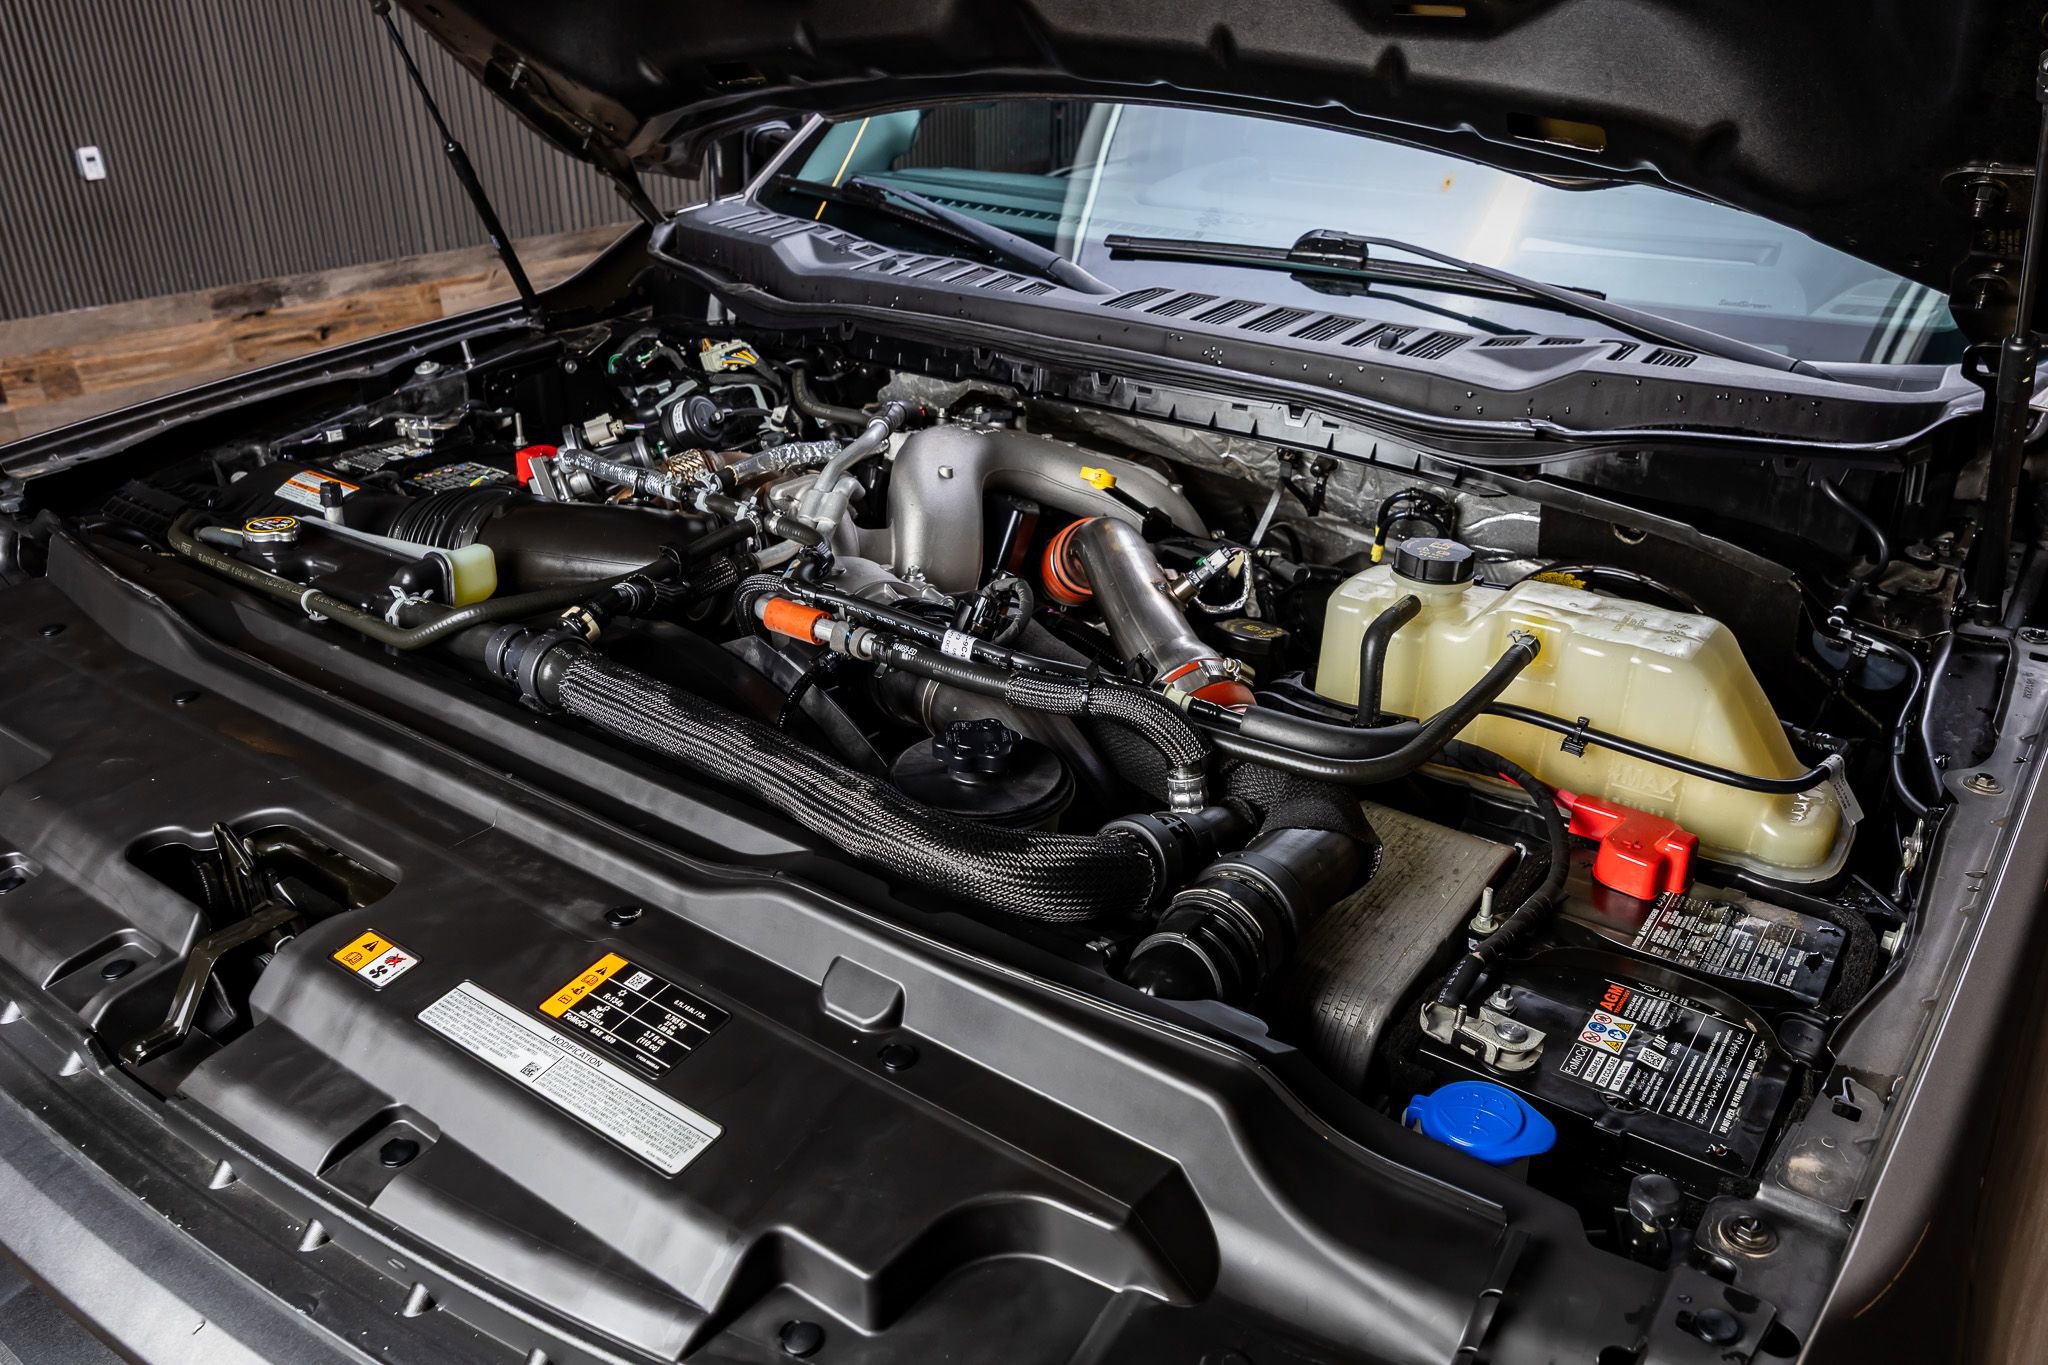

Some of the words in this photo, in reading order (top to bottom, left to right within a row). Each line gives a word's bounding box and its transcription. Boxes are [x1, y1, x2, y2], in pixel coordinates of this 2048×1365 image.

[1600, 985, 1623, 1010] AGM
[563, 1012, 588, 1028] FoMoCo
[551, 1035, 603, 1067] MODIFICATION
[1653, 1034, 1667, 1050] MF
[1565, 1045, 1588, 1074] FoMoCo
